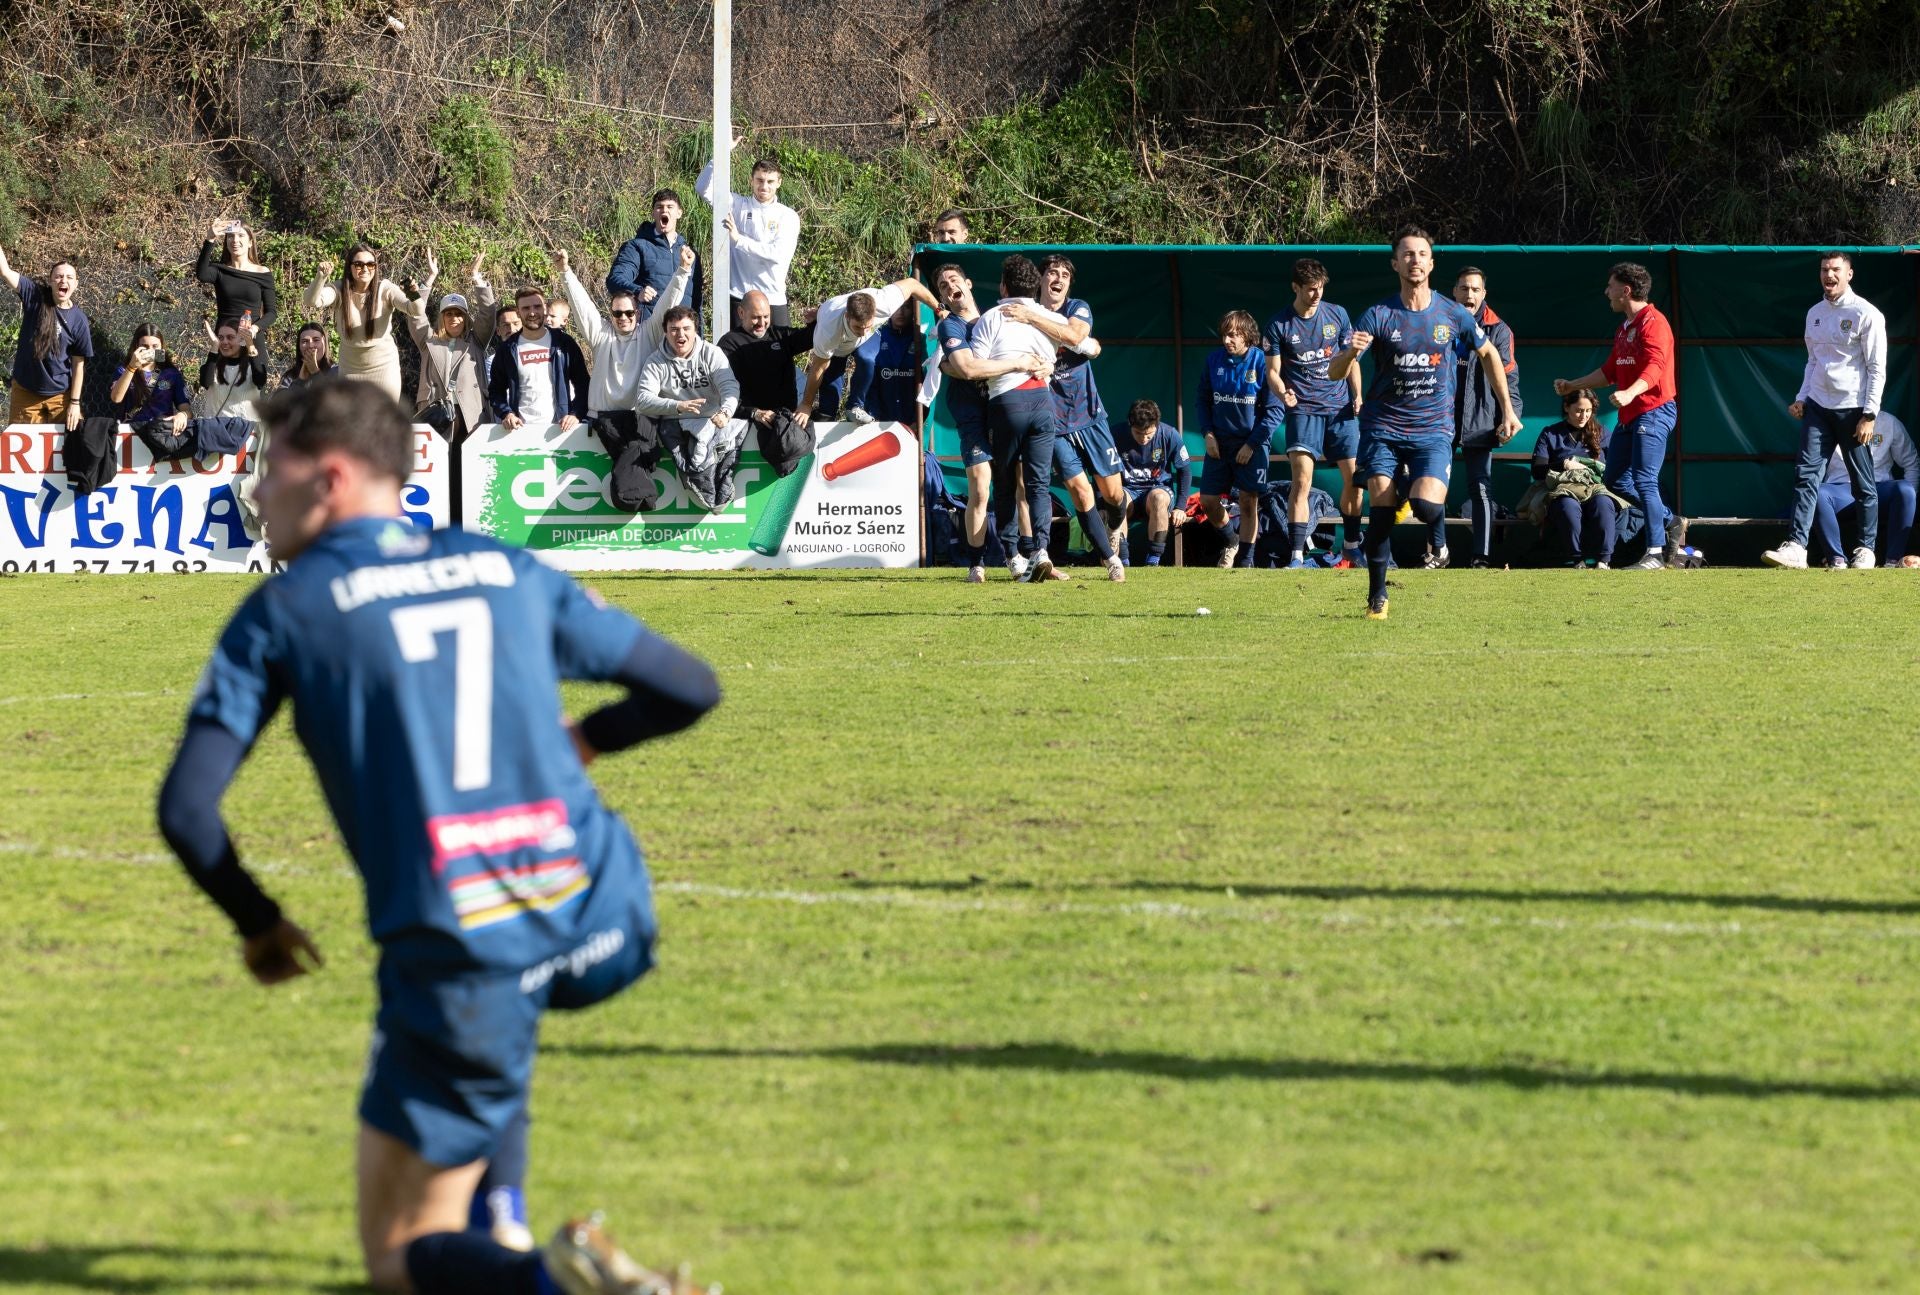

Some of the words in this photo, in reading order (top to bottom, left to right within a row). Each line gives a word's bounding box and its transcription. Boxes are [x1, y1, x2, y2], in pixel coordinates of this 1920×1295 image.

[1106, 447, 1121, 466] 2
[817, 502, 903, 516] Hermanos
[552, 528, 618, 543] PINTURA
[623, 527, 717, 542] DECORATIVA
[795, 521, 852, 535] Muñoz
[857, 520, 905, 535] Sáenz
[787, 543, 843, 553] ANGUIANO
[853, 541, 906, 553] LOGROÑO
[390, 597, 494, 792] 7
